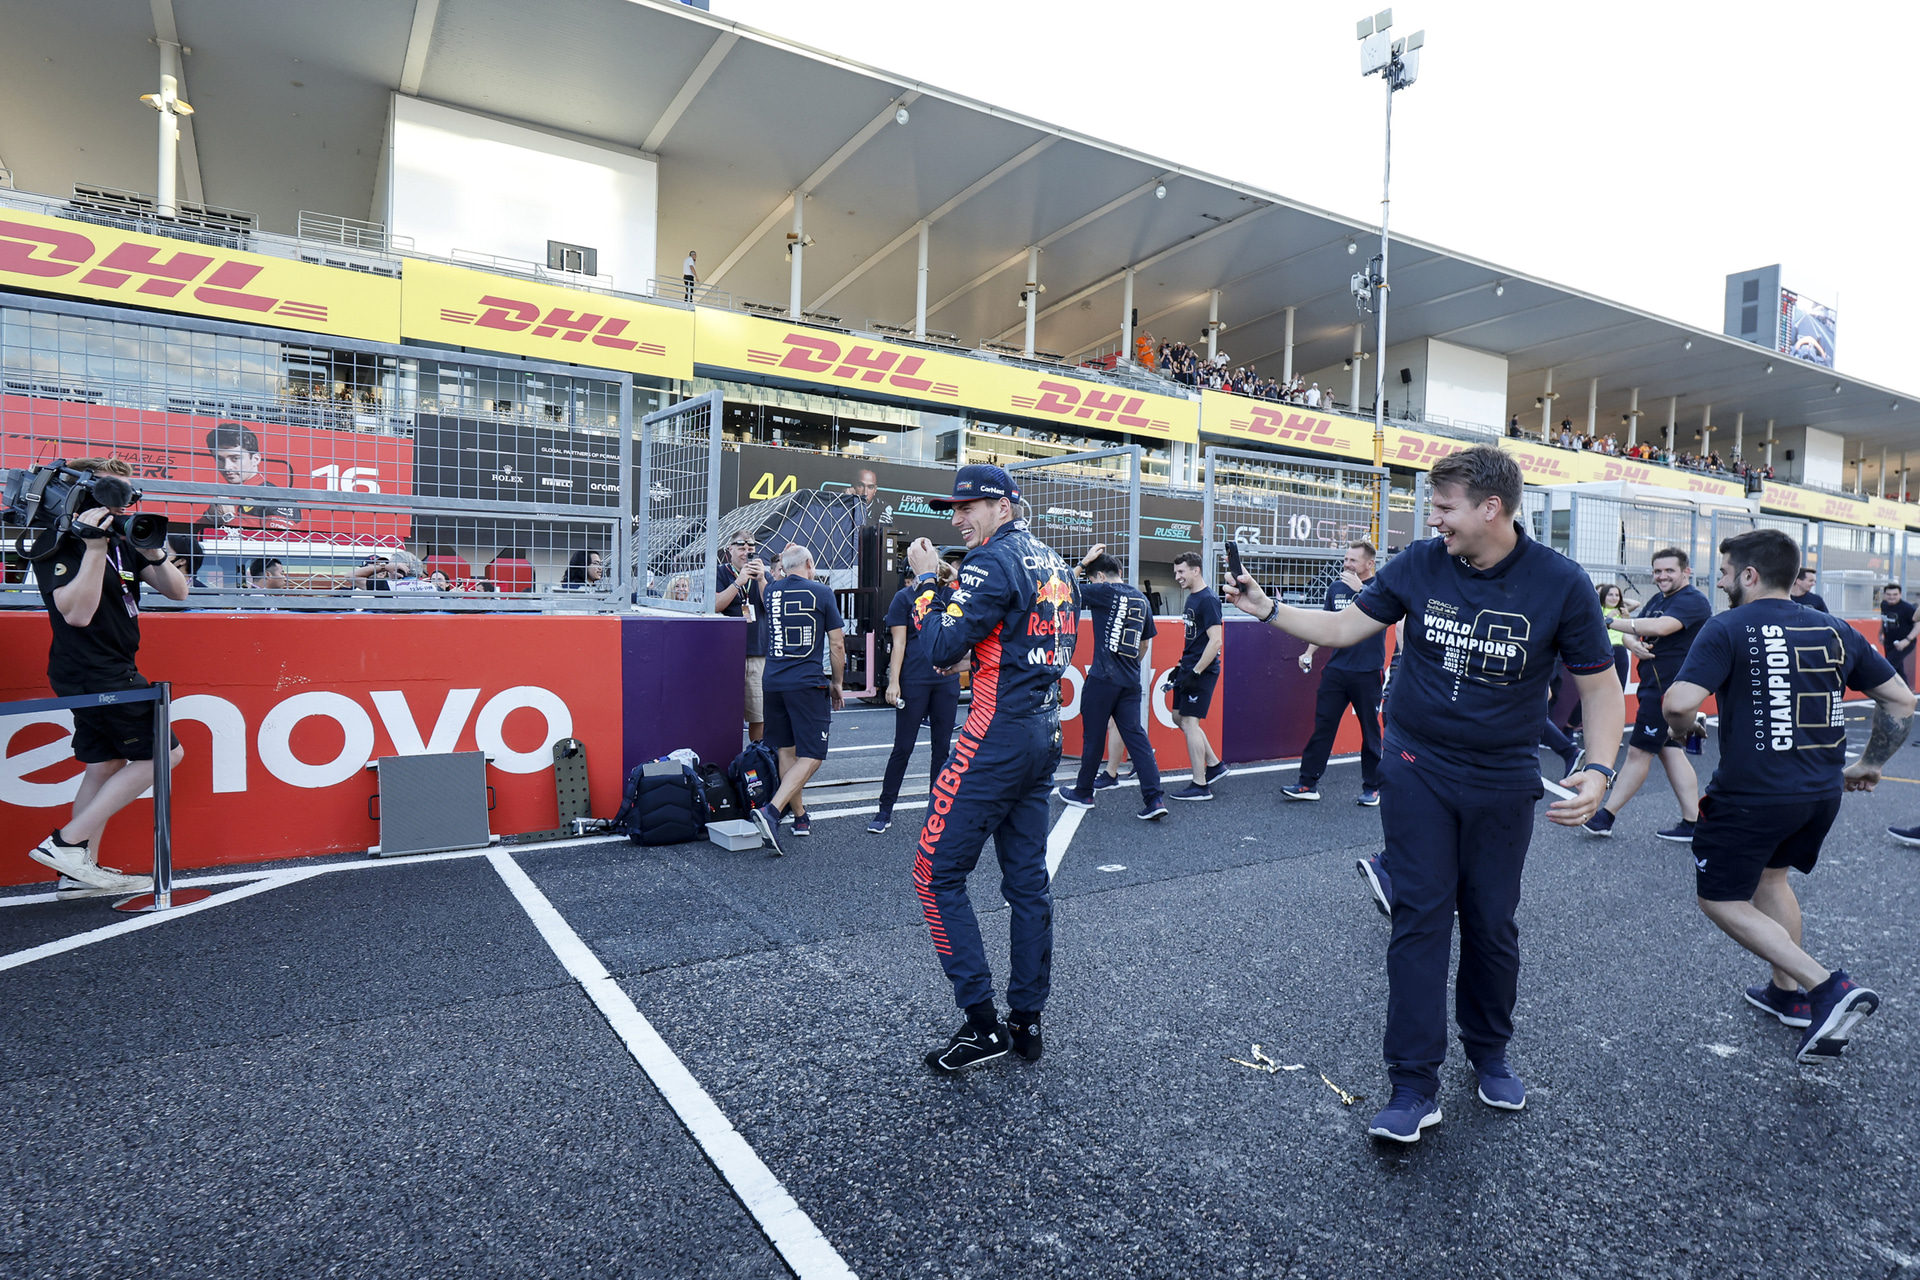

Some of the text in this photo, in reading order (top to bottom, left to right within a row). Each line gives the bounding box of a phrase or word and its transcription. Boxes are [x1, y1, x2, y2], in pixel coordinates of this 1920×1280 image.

[0, 220, 279, 312] DHL
[474, 295, 639, 351] DHL
[779, 333, 934, 392] DHL
[1034, 381, 1151, 428] DHL
[1248, 406, 1336, 447] DHL
[108, 451, 176, 465] CHARLES
[1396, 435, 1463, 464] DH
[1518, 453, 1562, 477] DHL
[311, 464, 381, 495] 16
[491, 474, 524, 483] ROLEX
[590, 482, 620, 492] aram
[749, 472, 798, 500] 44
[901, 494, 924, 503] LEWIS
[1765, 486, 1800, 509] DHL
[1825, 499, 1855, 519] DHL
[1039, 514, 1093, 526] PETRONAS
[1154, 527, 1191, 539] RUSSELL
[1171, 523, 1192, 531] GEORGE
[1288, 513, 1312, 541] 10
[1234, 526, 1261, 545] 63
[1428, 598, 1460, 611] ORACLE
[772, 590, 784, 657] CHAMPIONS
[1109, 595, 1128, 653] CHAMPIONS
[1424, 613, 1472, 636] WORLD
[1425, 629, 1517, 658] CHAMPIONS
[1761, 624, 1793, 751] CHAMPIONS
